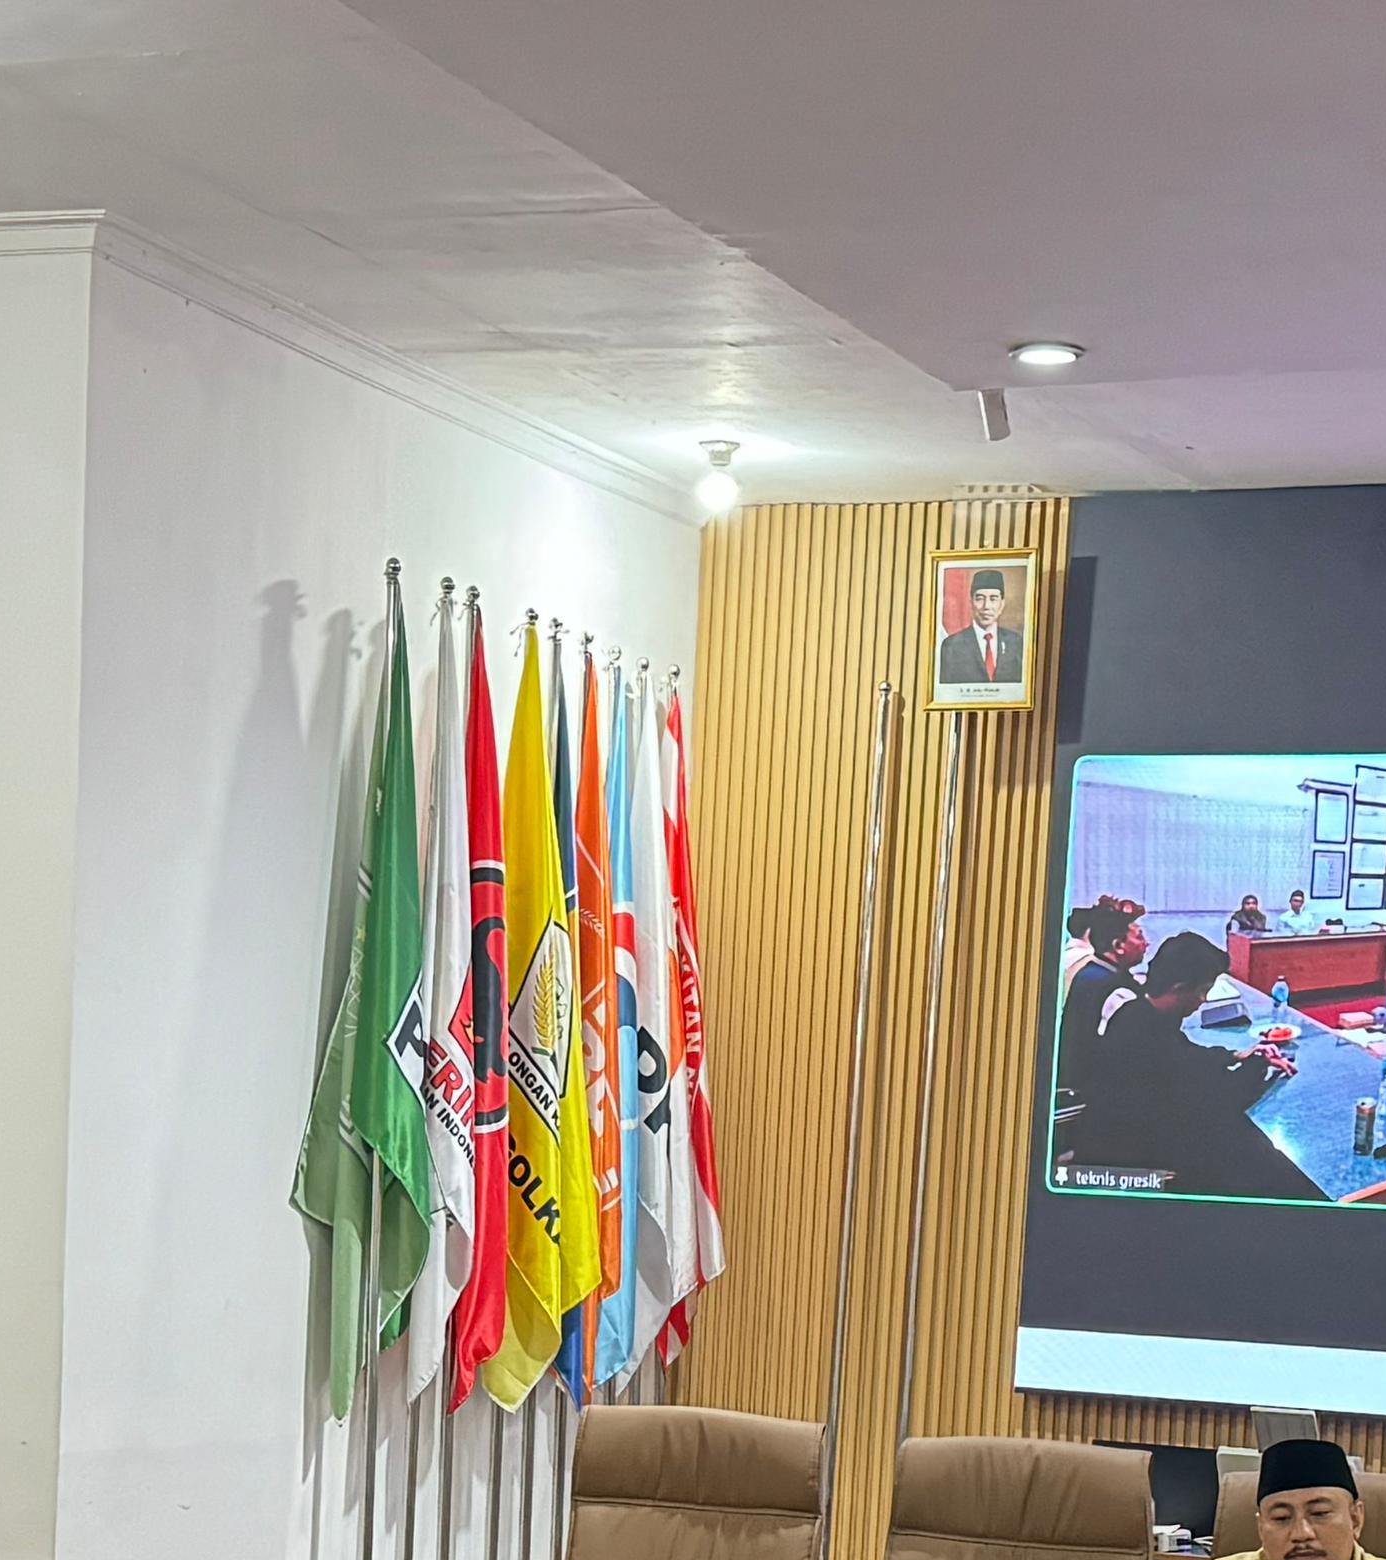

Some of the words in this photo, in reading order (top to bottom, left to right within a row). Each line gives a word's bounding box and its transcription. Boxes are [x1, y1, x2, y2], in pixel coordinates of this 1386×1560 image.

[508, 1050, 553, 1111] ONGAN
[1075, 1170, 1116, 1187] teknis
[1119, 1172, 1162, 1190] gresik
